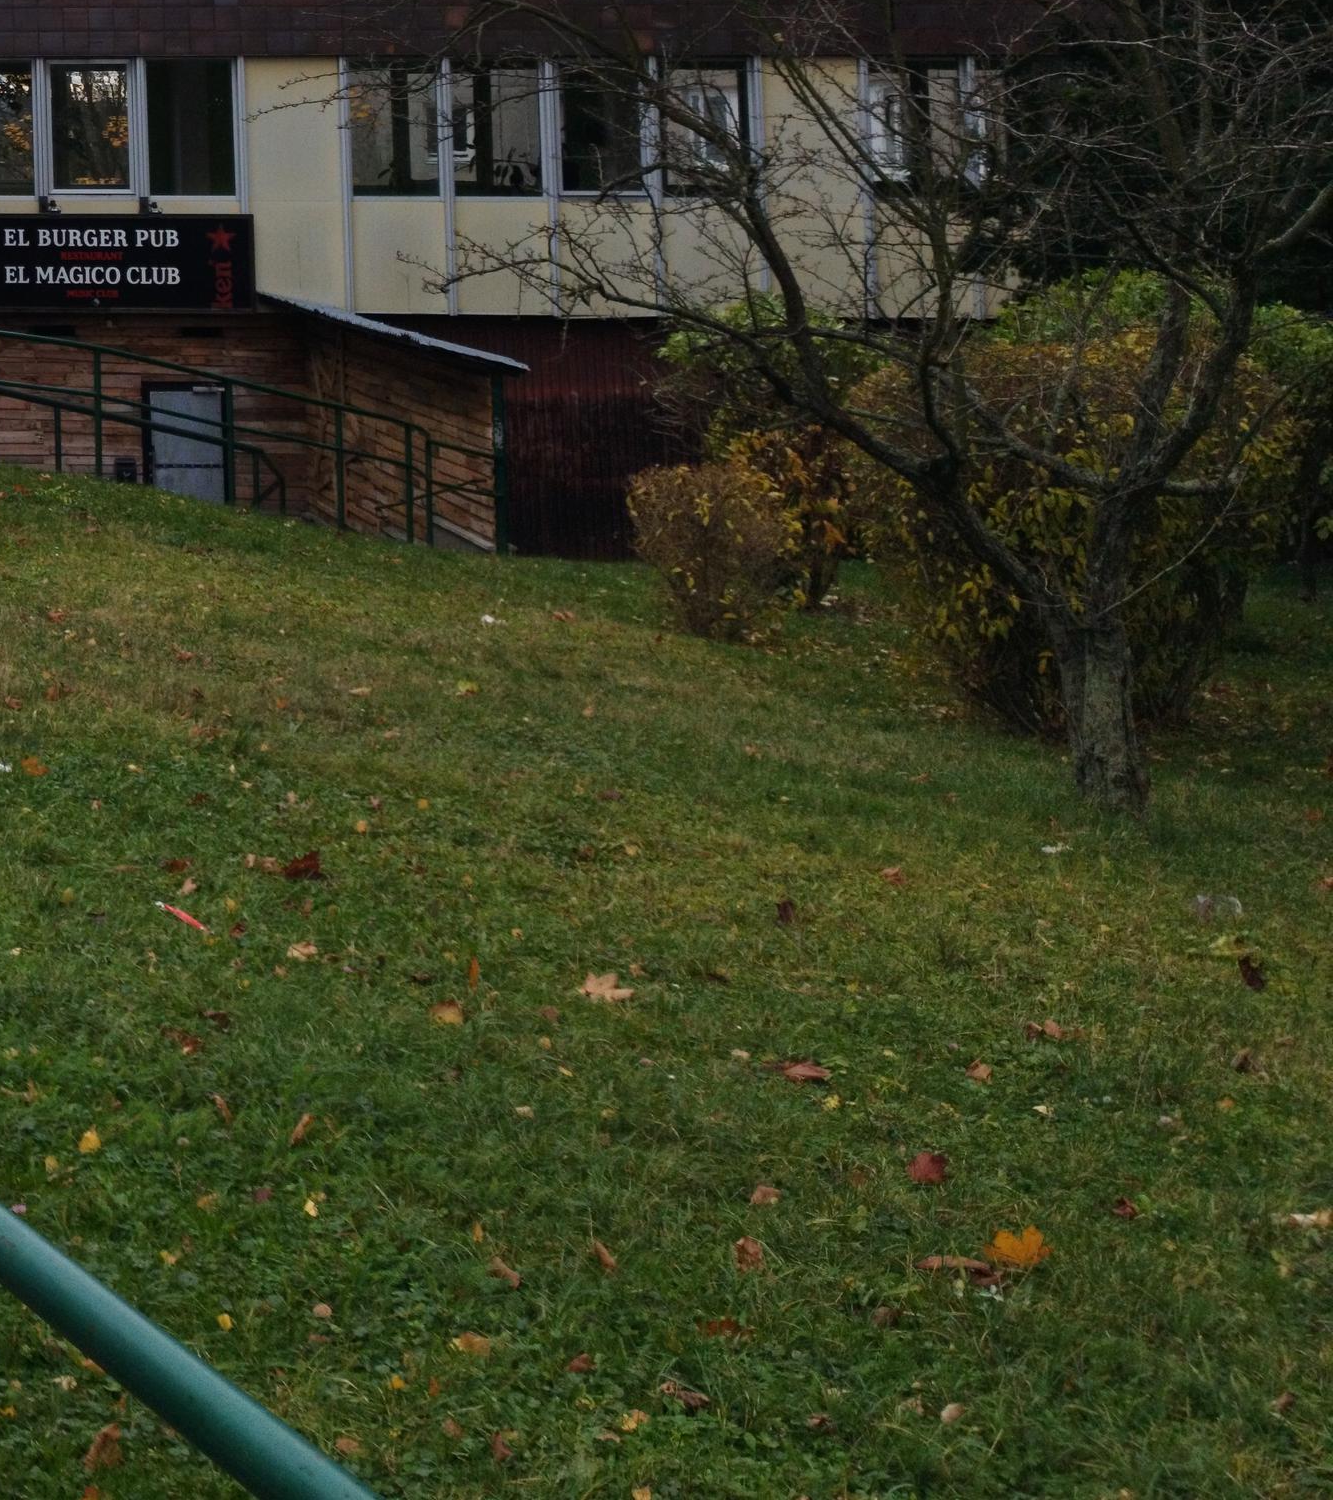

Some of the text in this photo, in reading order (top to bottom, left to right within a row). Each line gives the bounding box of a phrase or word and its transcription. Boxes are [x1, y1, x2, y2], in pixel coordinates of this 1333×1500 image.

[3, 229, 180, 248] EL BURGER PUB
[60, 251, 124, 261] RESTAURANT
[4, 265, 182, 285] EL MAGICO CLUB
